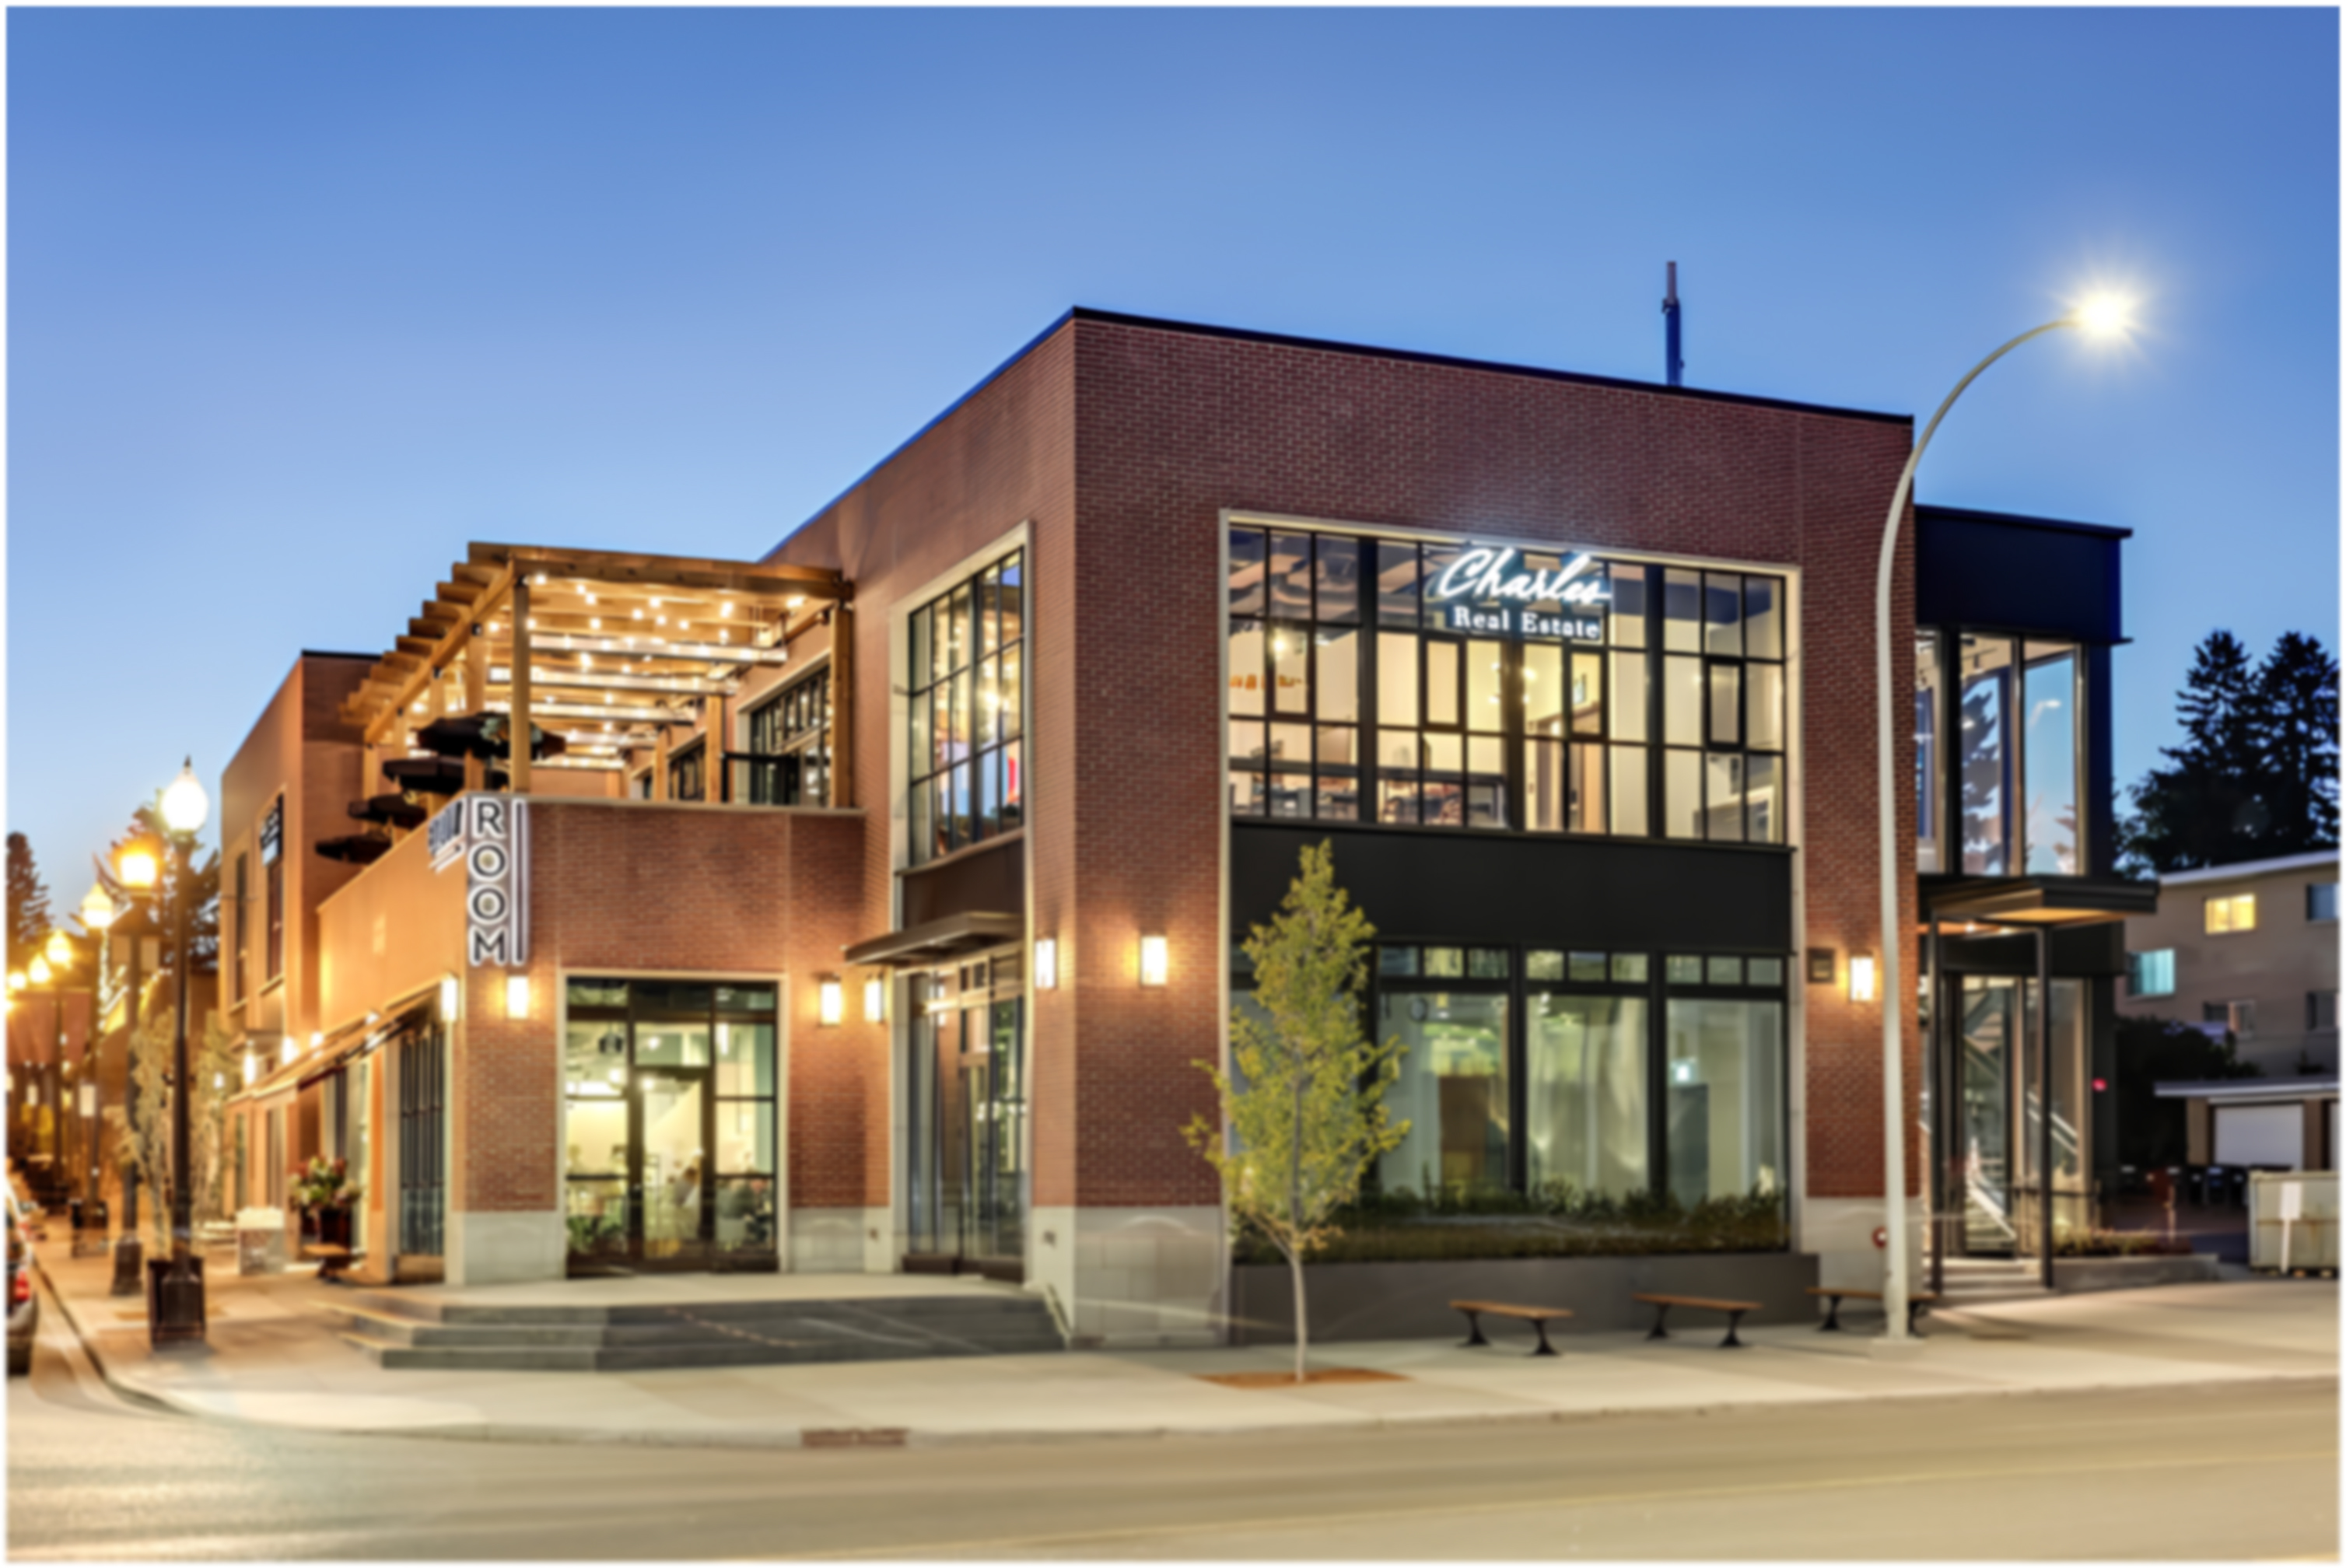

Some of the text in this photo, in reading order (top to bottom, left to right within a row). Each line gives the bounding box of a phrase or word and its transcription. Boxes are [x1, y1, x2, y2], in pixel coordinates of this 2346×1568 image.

[1437, 546, 1612, 604] Charles
[1452, 604, 1602, 639] Real Estate
[468, 796, 509, 967] ROOM
